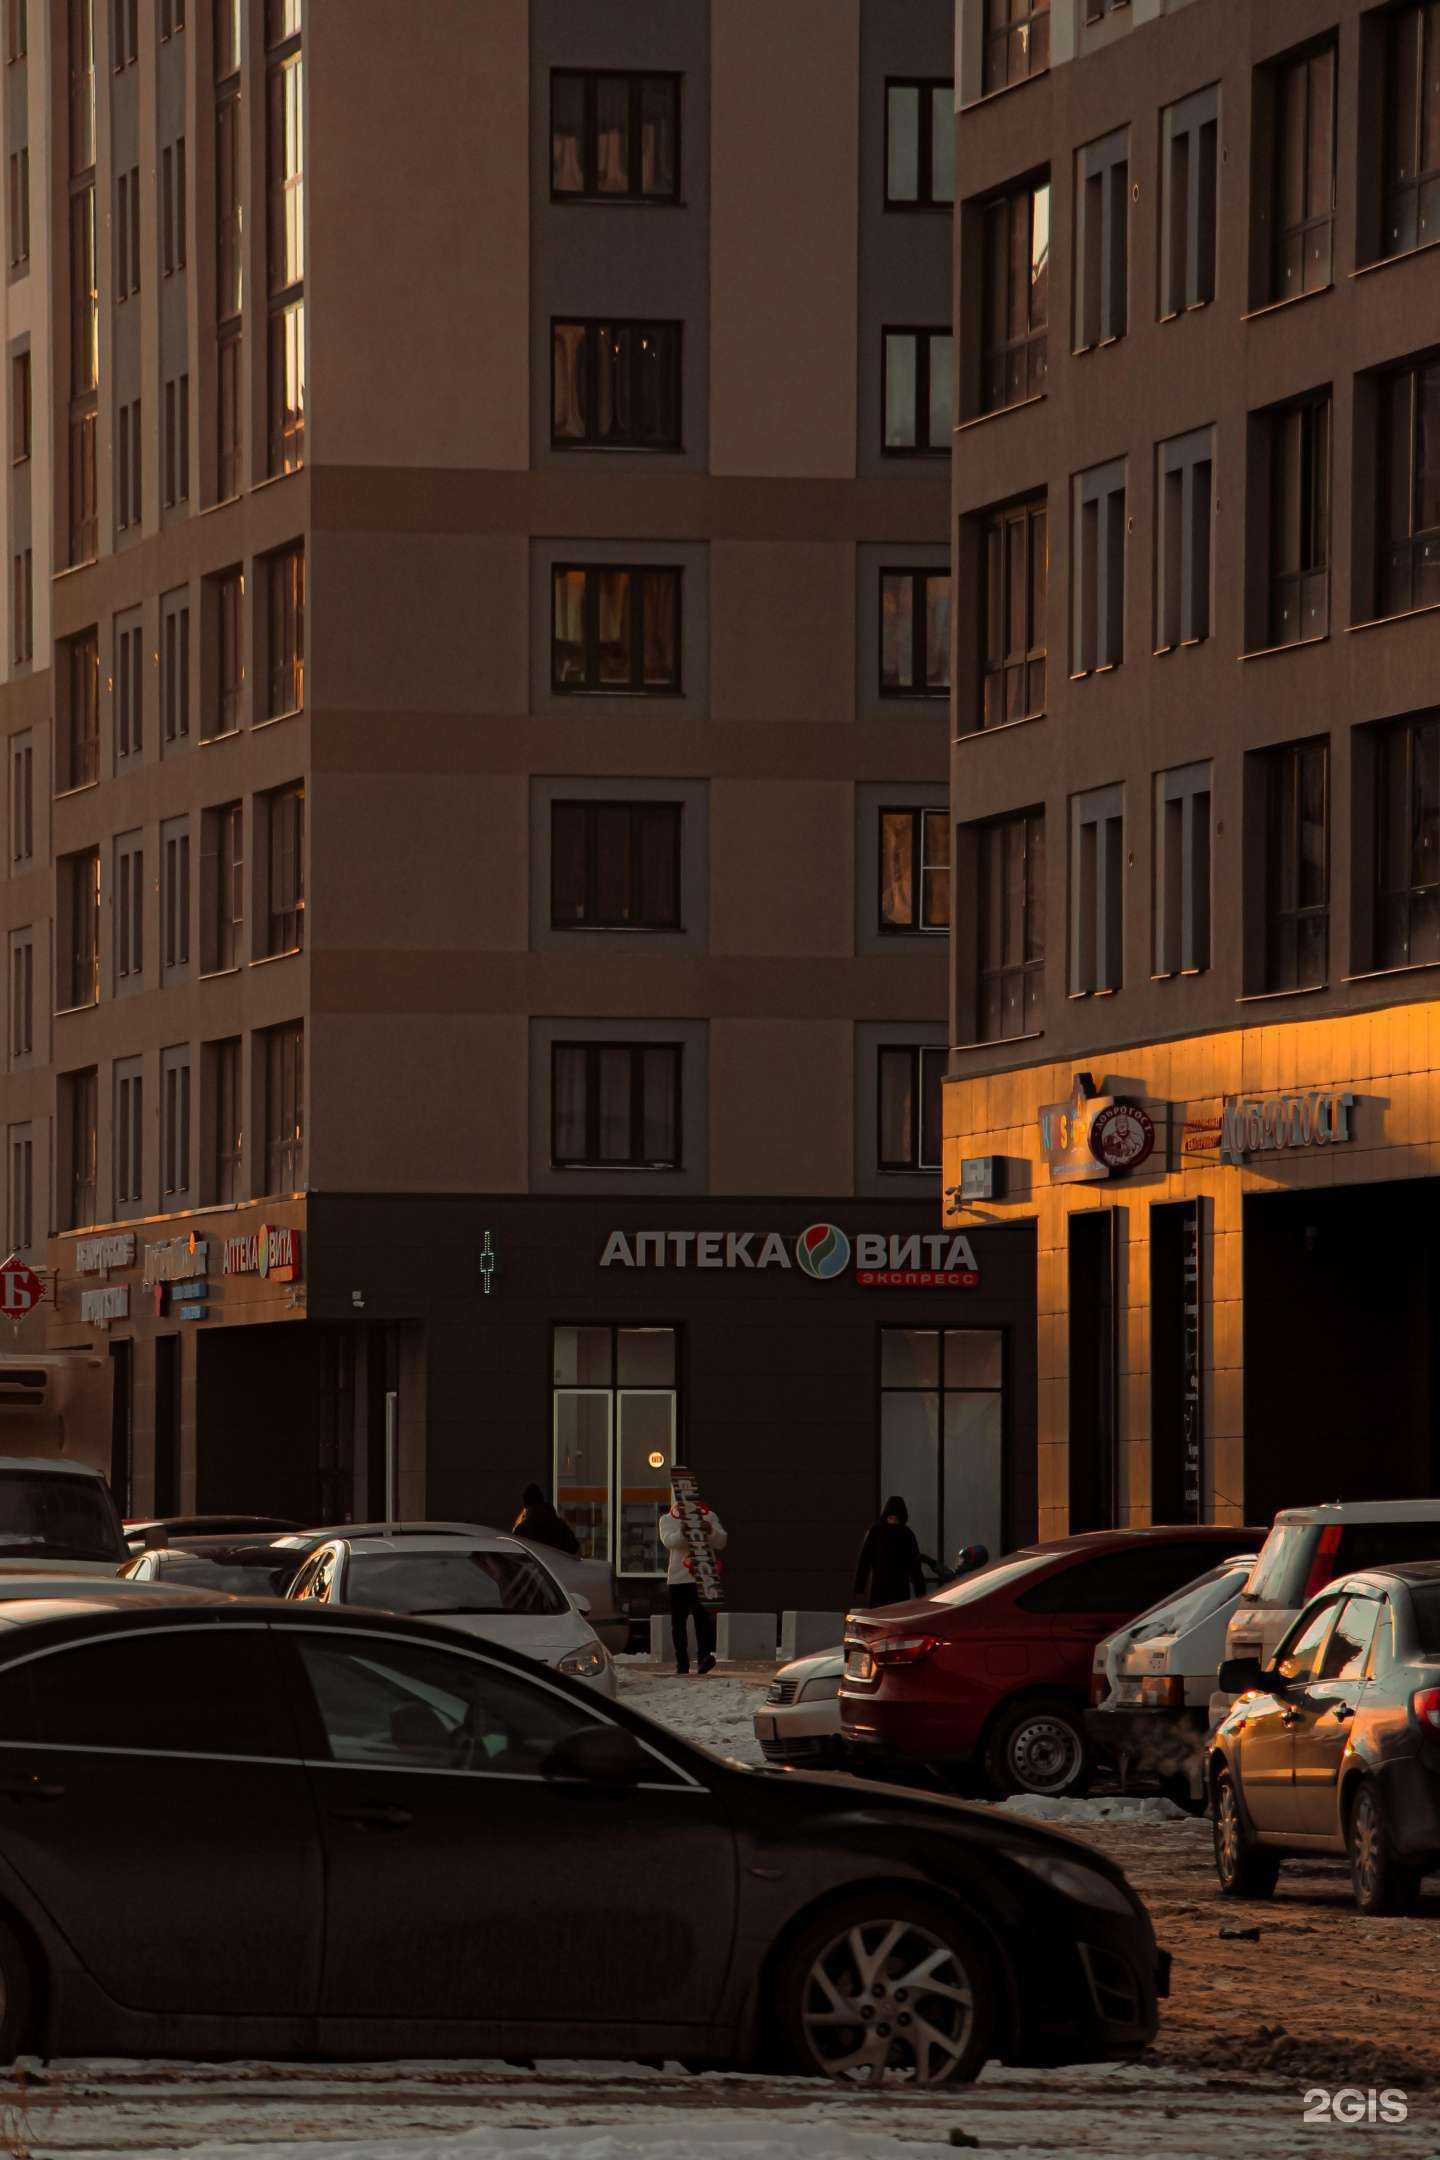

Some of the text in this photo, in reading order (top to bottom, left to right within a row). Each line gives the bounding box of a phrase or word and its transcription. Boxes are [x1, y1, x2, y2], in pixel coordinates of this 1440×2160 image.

[223, 1234, 258, 1275] АПТЕКА
[269, 1230, 293, 1266] ВИТА
[600, 1230, 979, 1270] АПТЕКА ВИТА
[1, 1271, 32, 1309] Б
[863, 1273, 975, 1285] ЭКСПРЕСС
